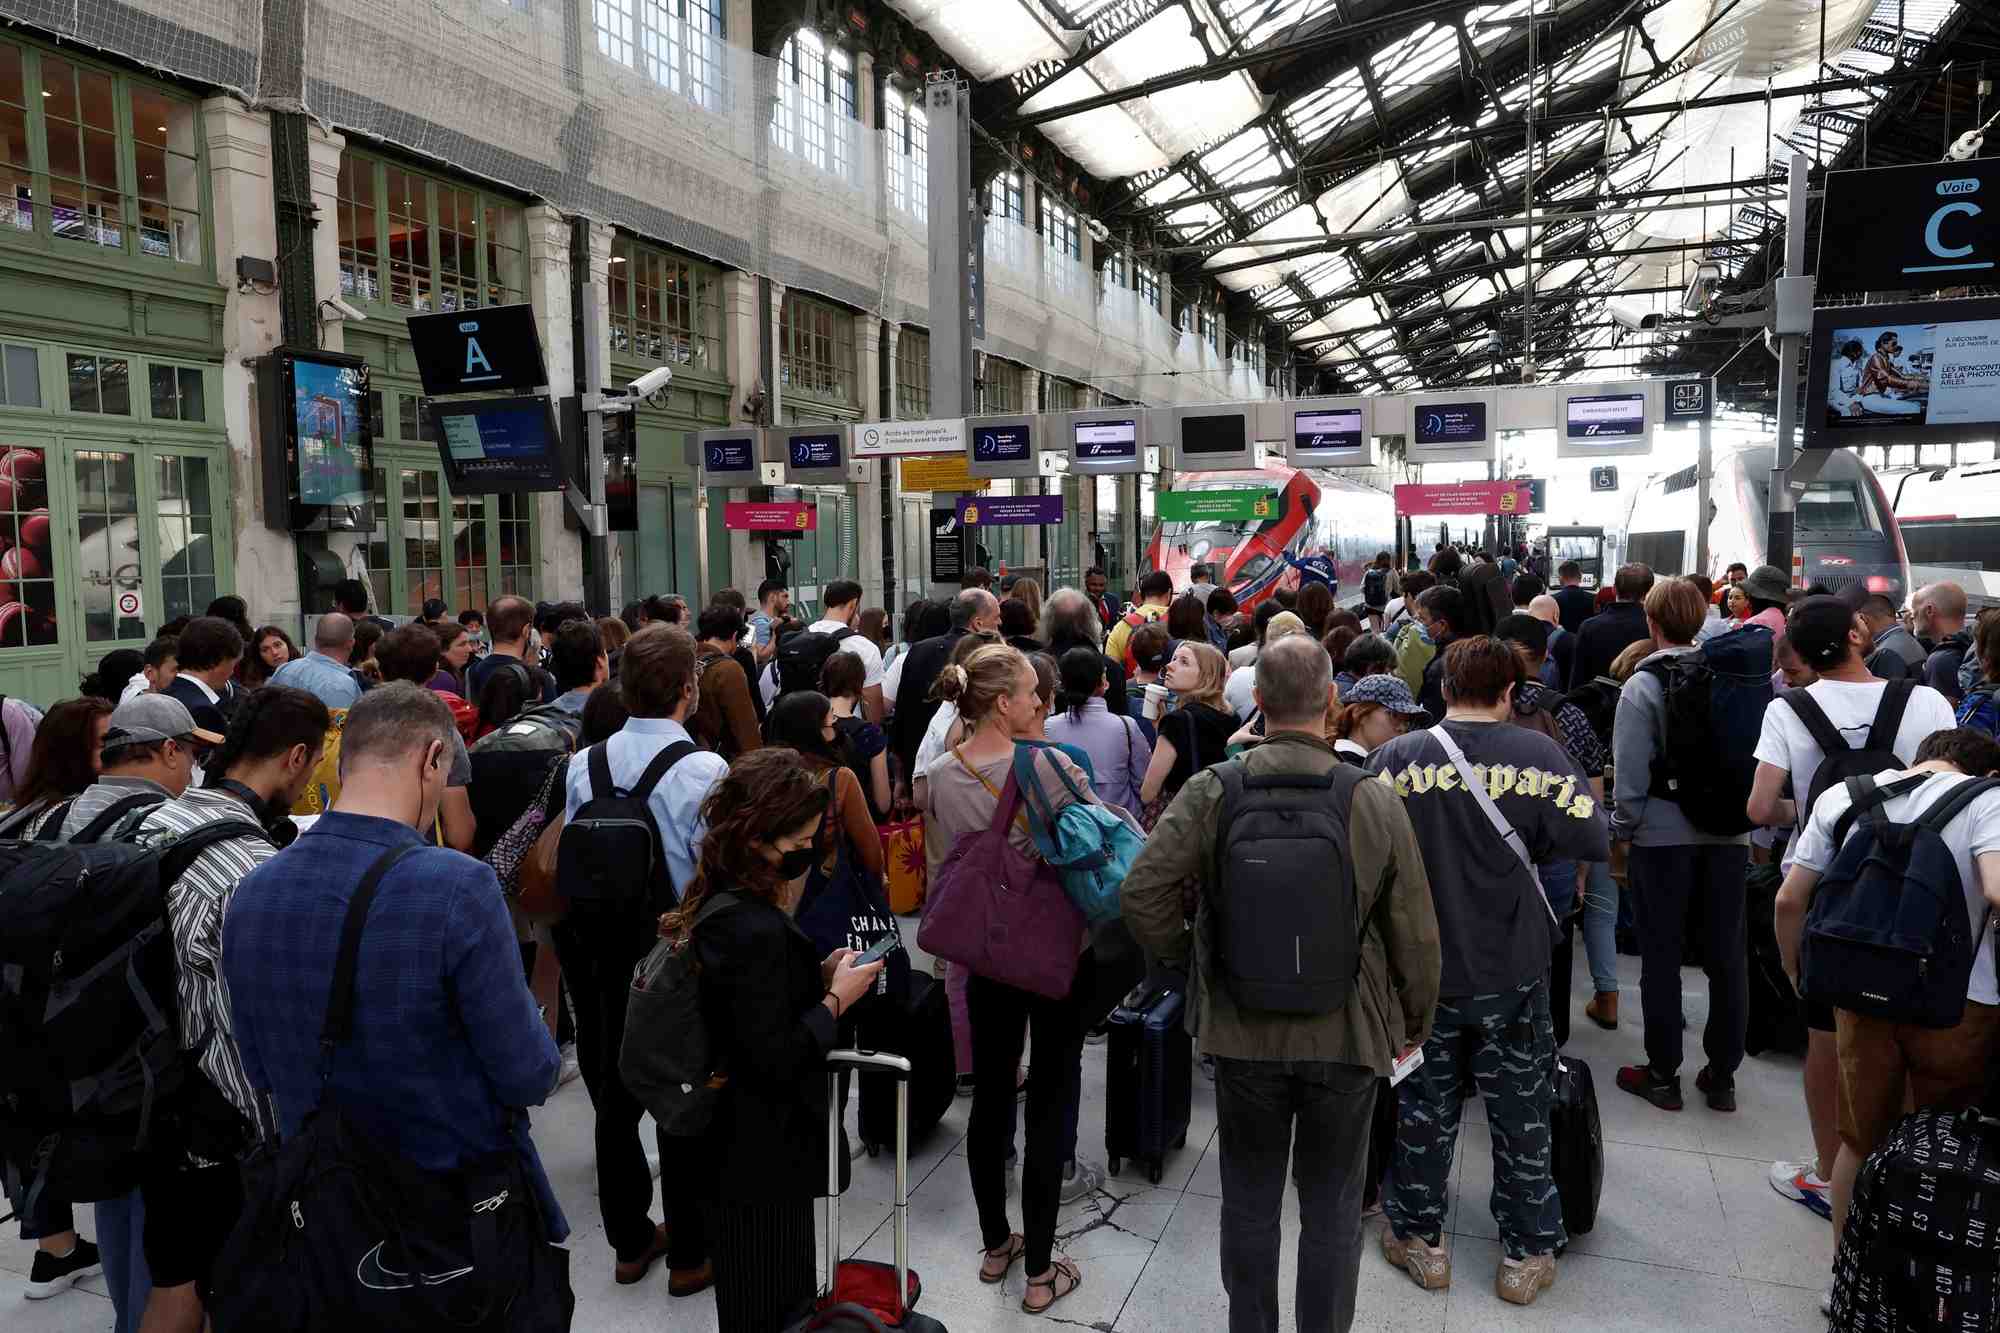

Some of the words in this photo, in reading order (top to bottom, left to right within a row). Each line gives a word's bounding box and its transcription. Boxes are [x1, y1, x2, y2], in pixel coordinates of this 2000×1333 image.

[1943, 182, 1973, 192] Voie
[1925, 202, 1982, 258] C
[466, 337, 492, 373] A
[1966, 1217, 1986, 1248] ZRH
